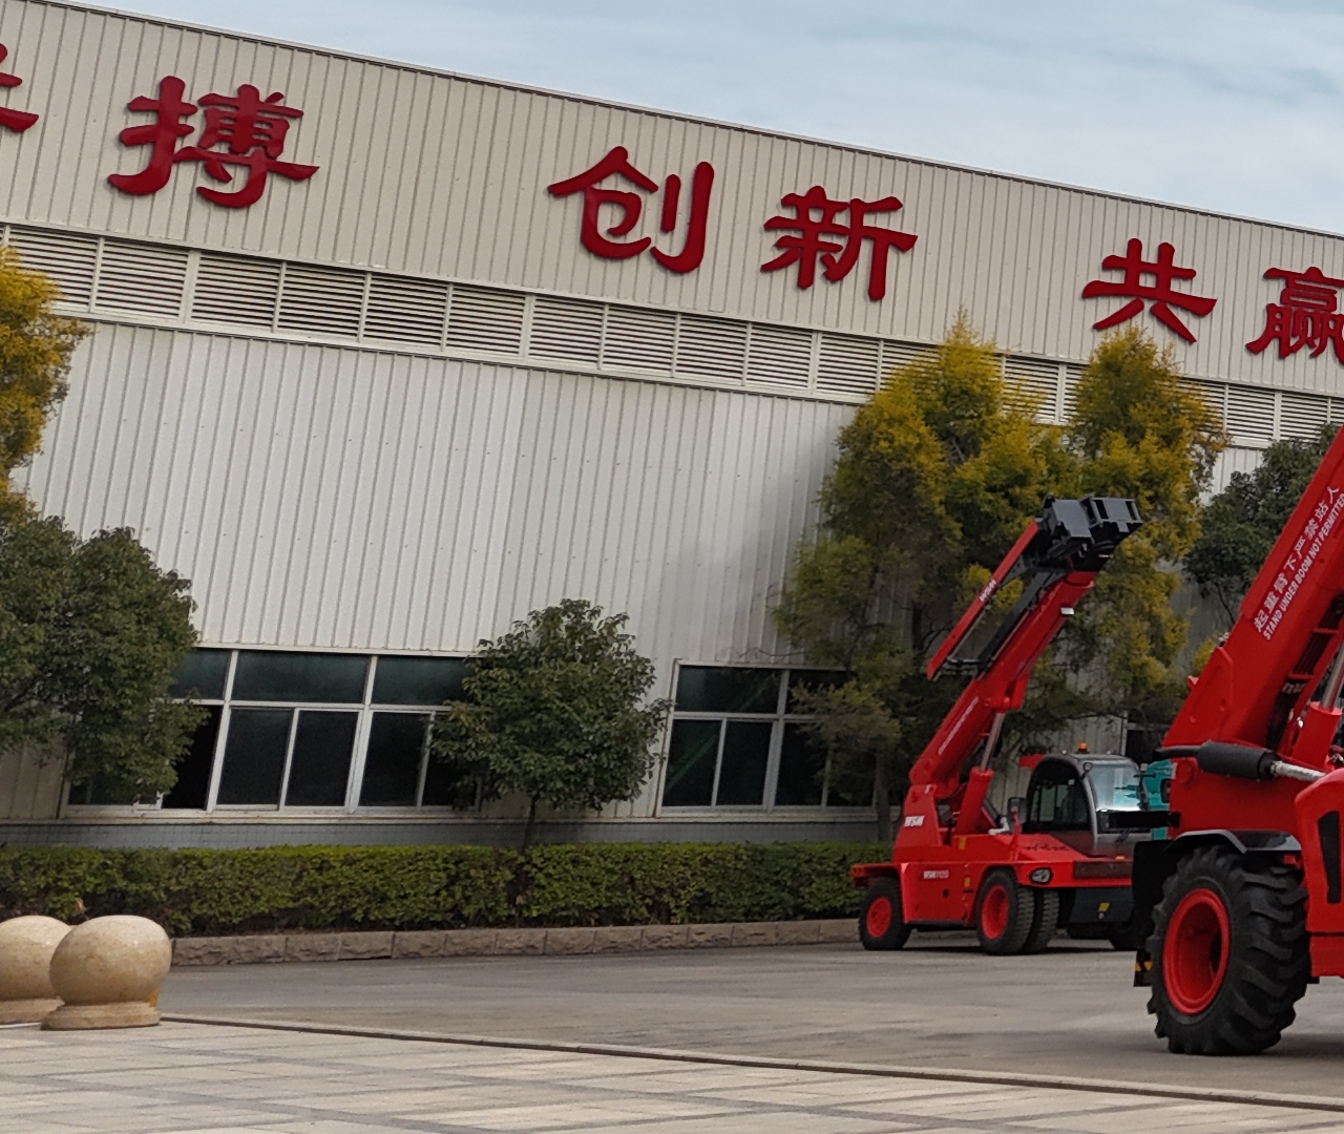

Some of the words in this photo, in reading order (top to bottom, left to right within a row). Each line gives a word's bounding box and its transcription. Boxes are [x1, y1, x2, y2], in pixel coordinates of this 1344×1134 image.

[547, 146, 918, 301] 创新
[1263, 609, 1283, 641] STAND
[1279, 580, 1300, 613] UNDER
[1294, 554, 1313, 585] BOOM
[1308, 536, 1323, 557] NOT
